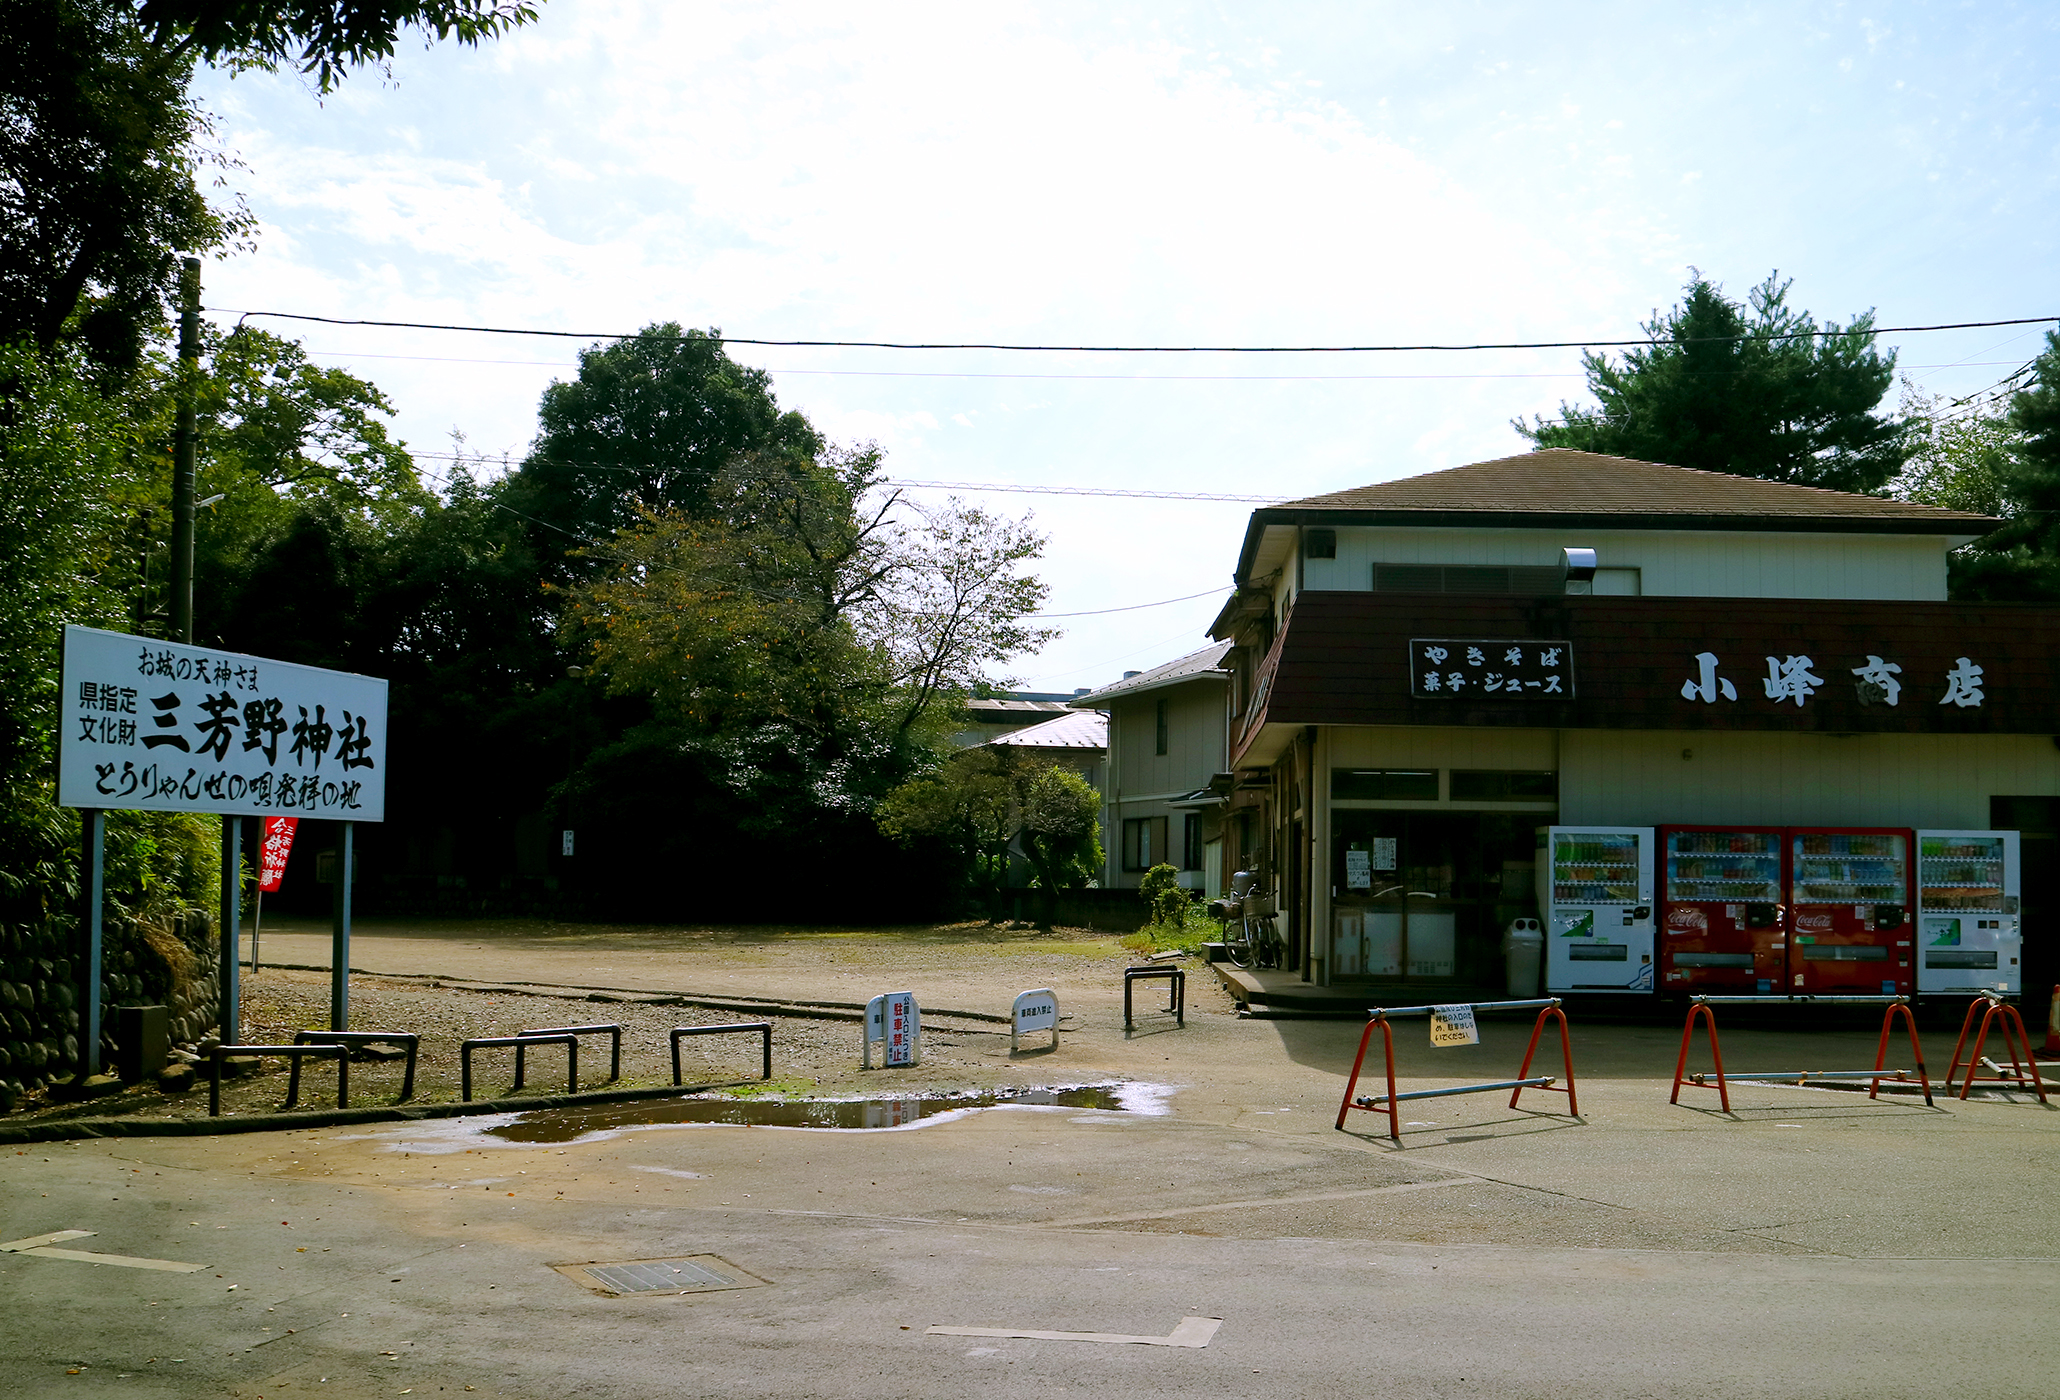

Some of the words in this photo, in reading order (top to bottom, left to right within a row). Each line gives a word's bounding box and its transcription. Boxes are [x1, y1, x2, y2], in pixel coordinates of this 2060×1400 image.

[138, 646, 259, 692] お城の天神さま
[1424, 646, 1562, 667] やきそば
[1680, 651, 1985, 708] 小峰商店
[79, 681, 138, 715] 県指定
[1423, 671, 1563, 694] 菓子・ジュース
[78, 715, 136, 746] 文化財
[139, 691, 375, 772] 三芳野神社
[893, 1003, 903, 1062] 駐車禁止
[902, 996, 910, 1061] 公園入口につき
